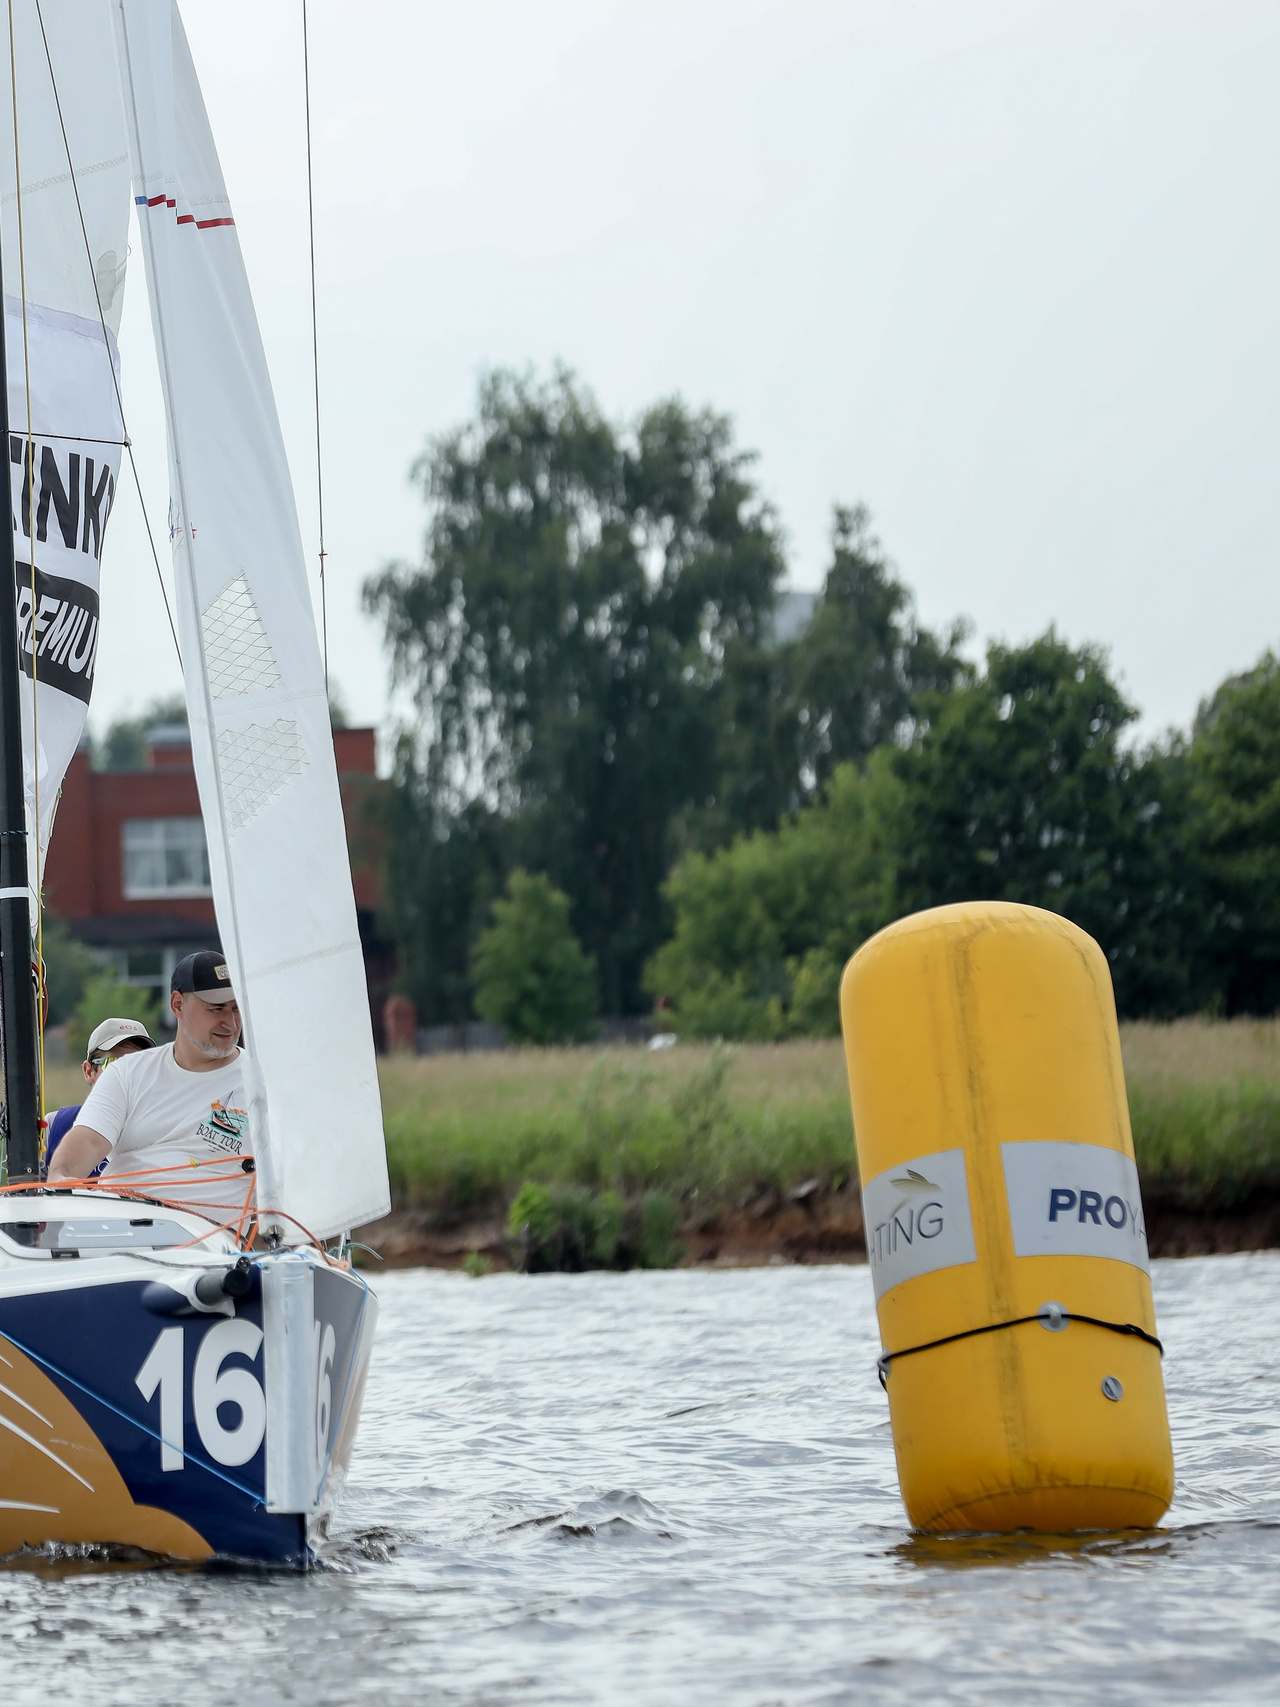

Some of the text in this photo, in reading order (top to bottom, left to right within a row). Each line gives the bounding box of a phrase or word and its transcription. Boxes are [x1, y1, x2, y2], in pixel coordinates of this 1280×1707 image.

[14, 585, 99, 681] REMIU
[196, 1123, 220, 1140] BOAT
[220, 1134, 243, 1156] TOUR
[134, 1318, 267, 1472] 16
